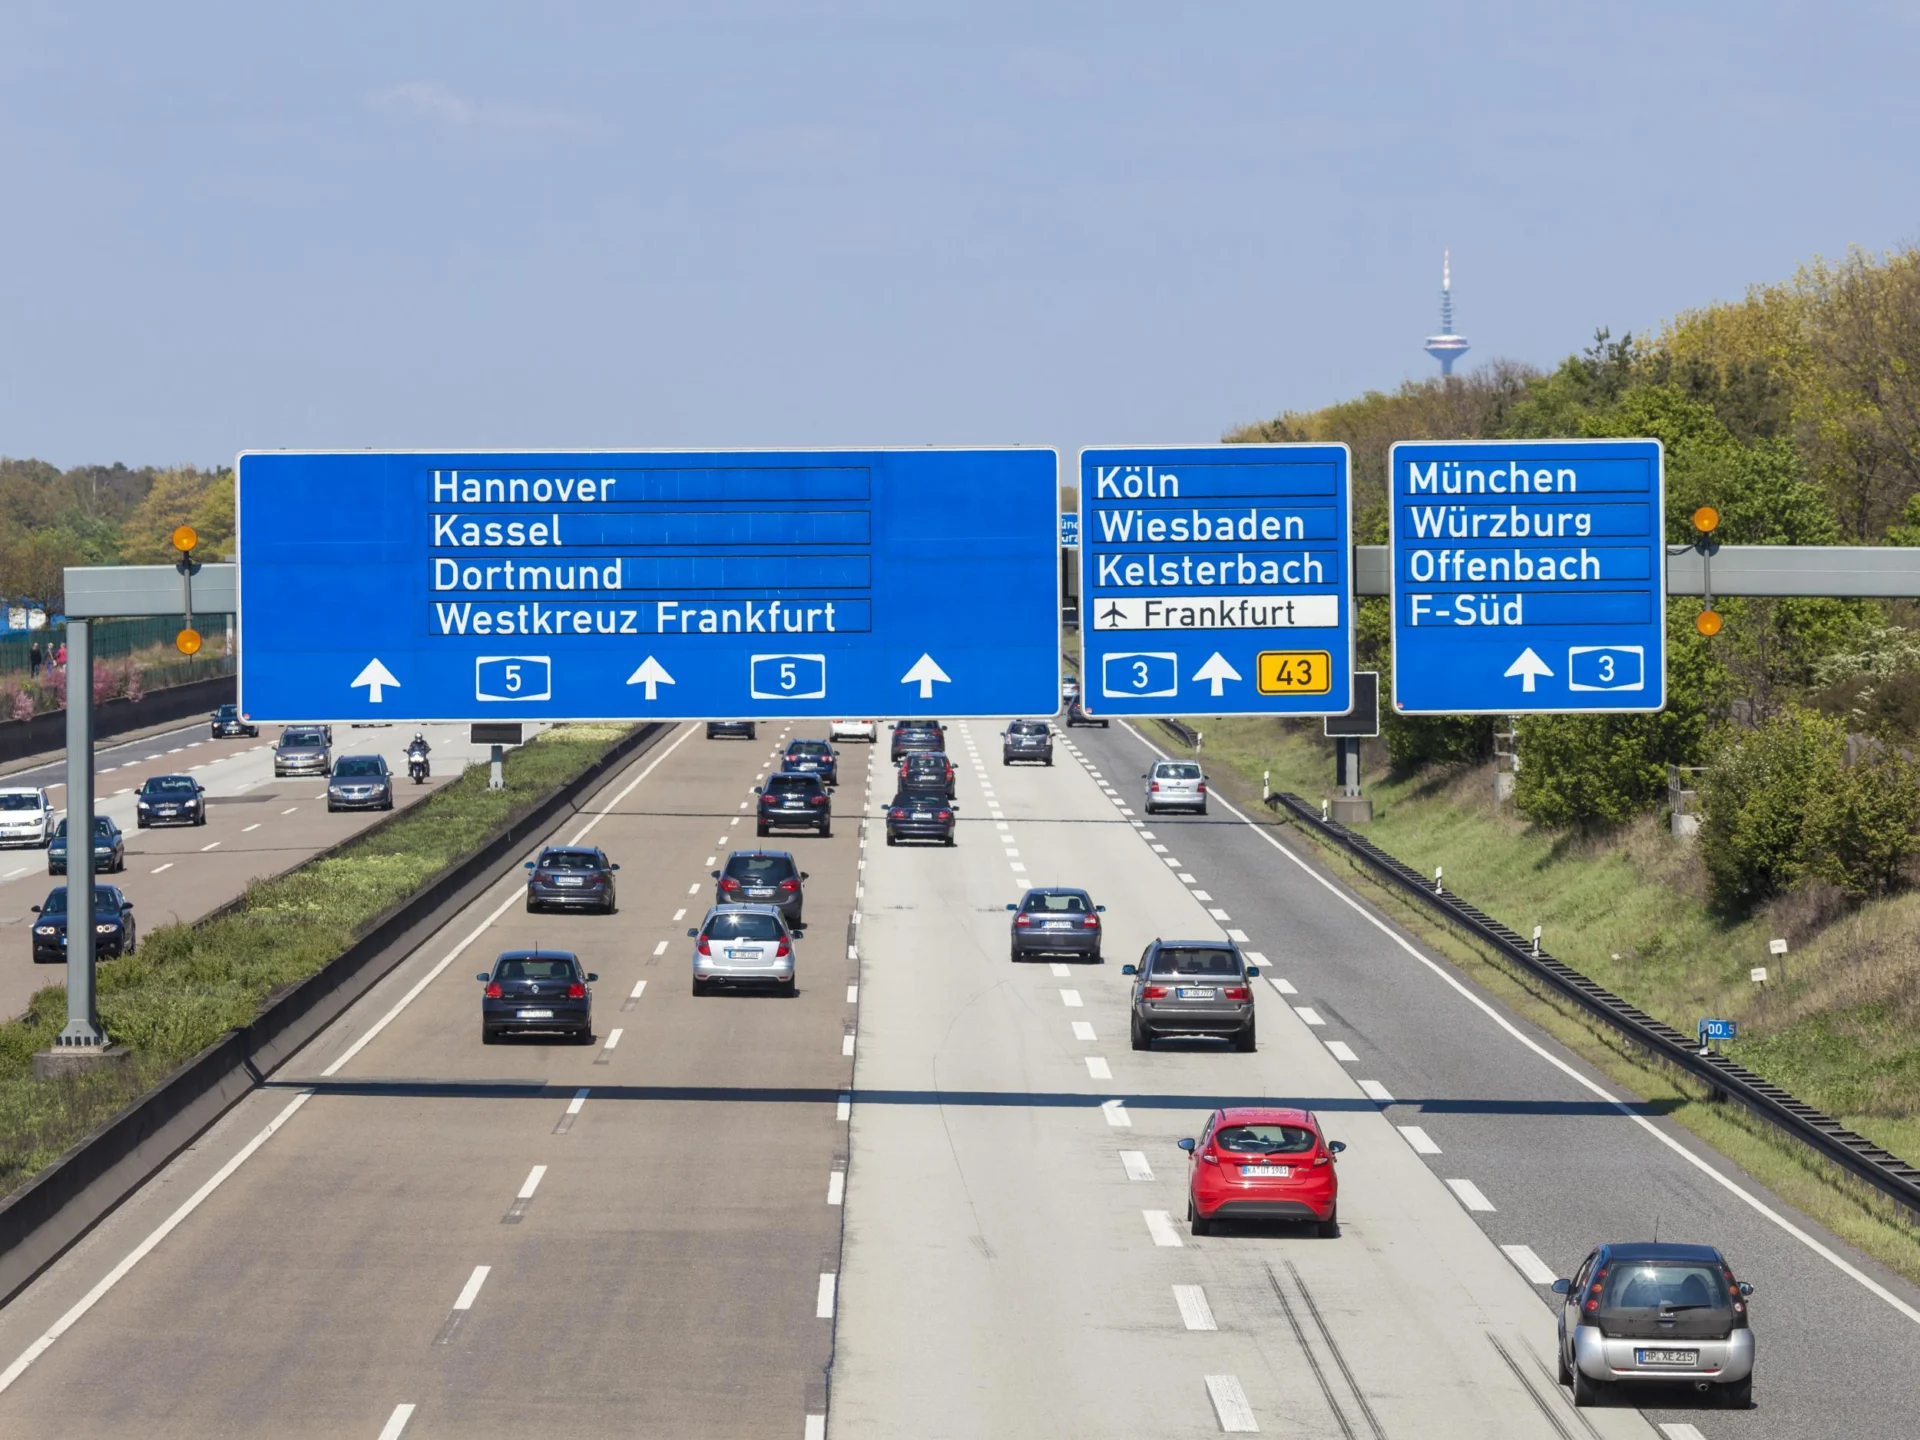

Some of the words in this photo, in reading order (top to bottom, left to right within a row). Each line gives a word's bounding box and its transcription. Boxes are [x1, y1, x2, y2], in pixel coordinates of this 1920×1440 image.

[435, 471, 616, 503] Hannover
[1098, 466, 1179, 498] Köln
[1411, 462, 1576, 494] München
[435, 513, 562, 547] Kassel
[1099, 510, 1304, 542] Wiesbaden
[1412, 506, 1591, 540] Würzburg
[436, 557, 622, 591] Dortmund
[1099, 552, 1324, 586] Kelsterbach
[1412, 549, 1600, 582] Offenbach
[436, 602, 639, 635] Westkreuz
[657, 601, 836, 633] Frankfurt
[1146, 600, 1295, 627] Frankfurt
[1412, 594, 1523, 627] F-Süd
[506, 665, 522, 691] 5
[780, 664, 796, 690] 5
[1132, 661, 1148, 688] 3
[1276, 660, 1312, 687] 43
[1599, 655, 1615, 682] 3
[1708, 1023, 1735, 1036] 00.5
[1644, 1351, 1657, 1361] HP
[1662, 1352, 1674, 1361] XE
[1675, 1352, 1693, 1361] 215
